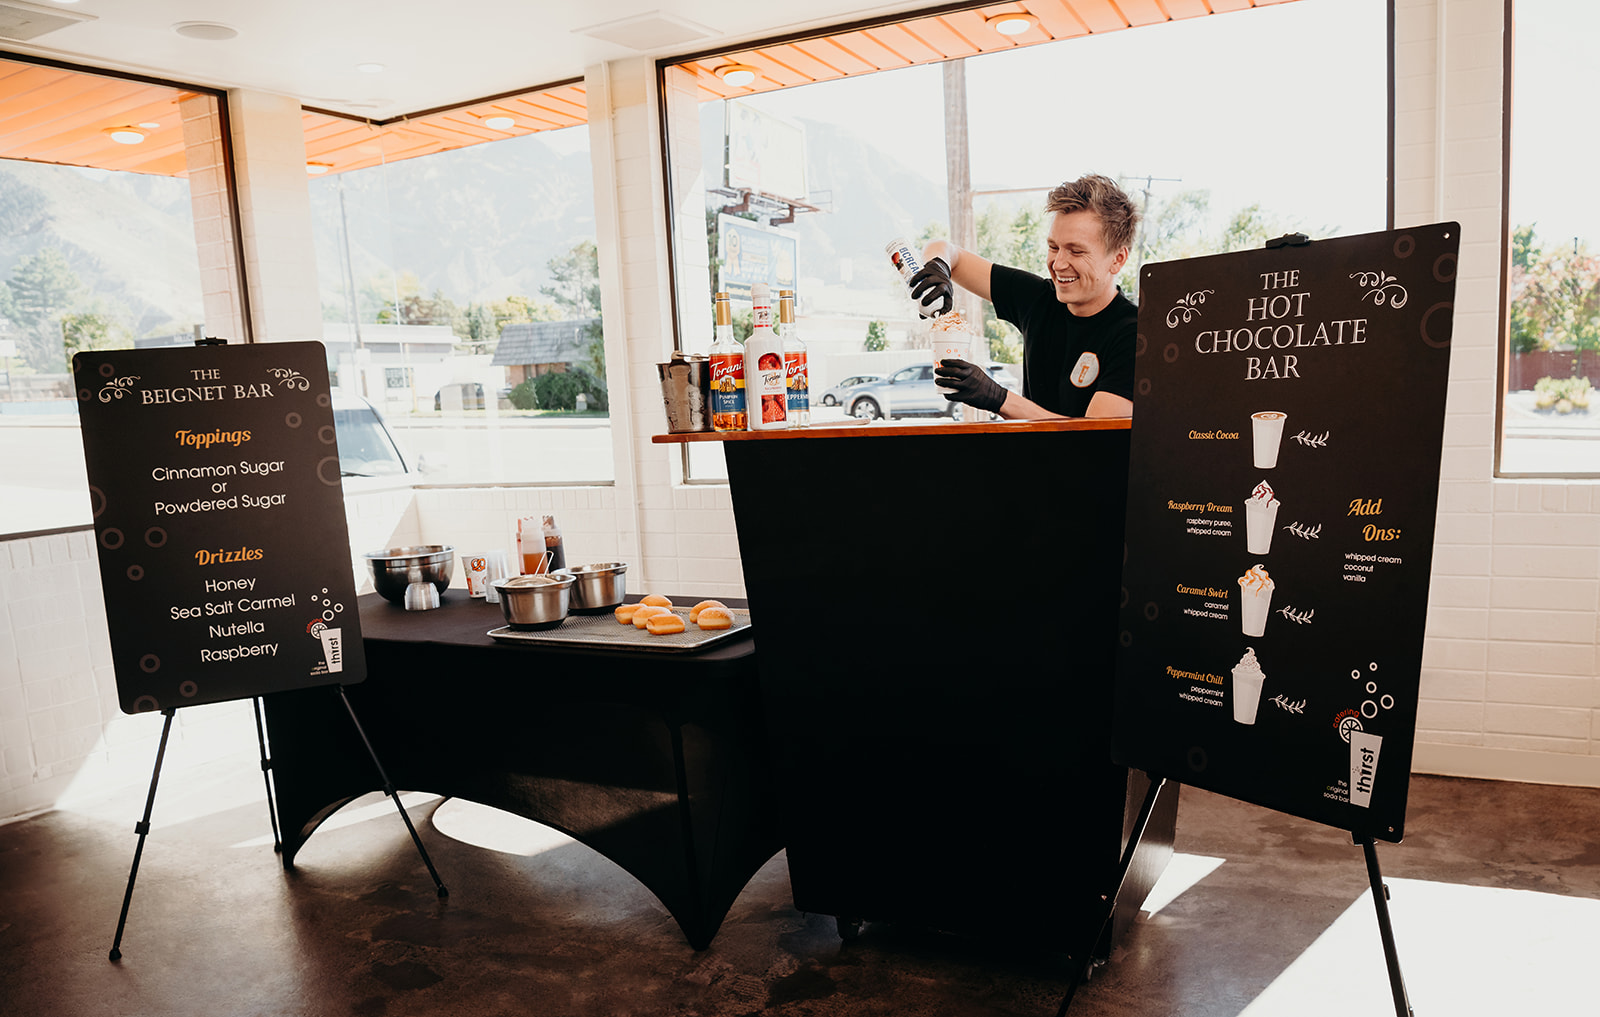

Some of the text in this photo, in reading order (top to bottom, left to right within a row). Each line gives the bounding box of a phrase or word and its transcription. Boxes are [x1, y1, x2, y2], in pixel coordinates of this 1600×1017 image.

[1260, 269, 1300, 290] THE
[1246, 292, 1311, 321] HOT
[1195, 318, 1368, 354] CHOCOLATE
[191, 368, 221, 381] THE
[711, 360, 743, 382] Torani
[1244, 355, 1301, 381] BAR
[140, 383, 275, 405] BEIGNET BAR
[175, 428, 252, 449] Toppings
[1188, 429, 1240, 440] Classic Cocoa
[152, 460, 285, 481] Cinnamon Sugar
[211, 482, 228, 493] or
[154, 493, 286, 516] Powdered Sugar
[1167, 499, 1233, 514] Raspberry Dream
[1347, 498, 1383, 517] Add
[1186, 518, 1213, 527] raspberry
[1186, 527, 1232, 537] whipped cream
[1362, 523, 1402, 542] Ons:
[194, 546, 264, 566] Drizzles
[1344, 552, 1402, 565] whipped cream
[1343, 564, 1374, 573] coconut
[205, 577, 256, 593] Honey
[1342, 574, 1367, 583] vanilla
[1176, 583, 1229, 599] Caramel Swirl
[170, 593, 296, 621] Sea Salt Carmel
[1183, 608, 1229, 620] whipped cream
[1203, 601, 1230, 611] caramel
[209, 620, 265, 639] Nutella
[200, 642, 279, 663] Raspberry
[329, 637, 341, 664] thirst
[1166, 665, 1224, 685] Peppermint Chill
[1178, 692, 1223, 707] whipped cream
[1190, 685, 1224, 698] peppermint
[1332, 708, 1360, 729] catering
[1356, 747, 1375, 794] thirst
